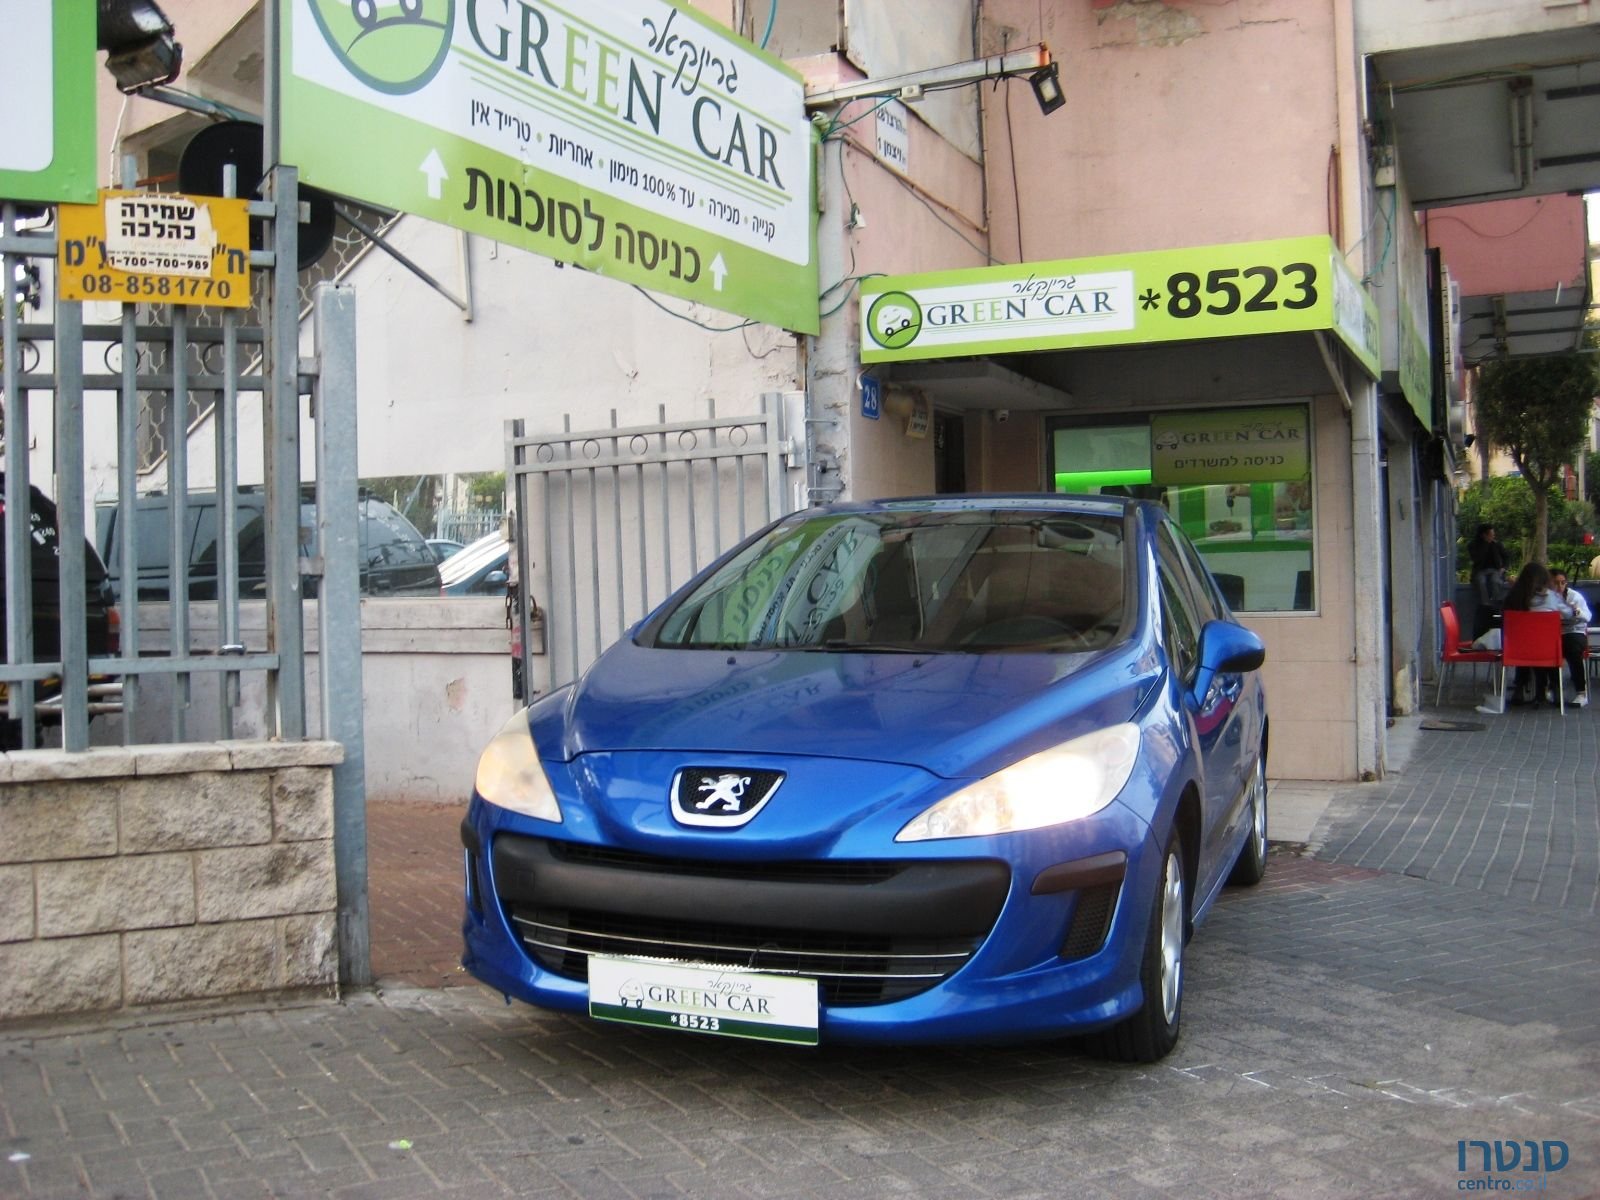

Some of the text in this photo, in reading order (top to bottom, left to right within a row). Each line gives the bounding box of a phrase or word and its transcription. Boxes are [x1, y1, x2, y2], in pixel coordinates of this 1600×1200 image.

[466, 0, 785, 190] GREEN CAR
[471, 99, 775, 242] קנייה מכירה עד 100% מימון אחריות טרייד אין
[121, 203, 195, 221] שמירה
[121, 221, 196, 240] כהלכה
[463, 167, 701, 284] כניסה לסוכנות
[110, 256, 209, 270] 1-700-700-989
[82, 274, 231, 299] 08-8581770
[927, 298, 1026, 326] GREEN
[1044, 291, 1115, 317] CAR
[864, 385, 877, 411] 28
[1183, 428, 1299, 444] GREEN CAR
[1175, 455, 1284, 469] כניסה למשרדים
[648, 986, 770, 1014] GREEN CAR
